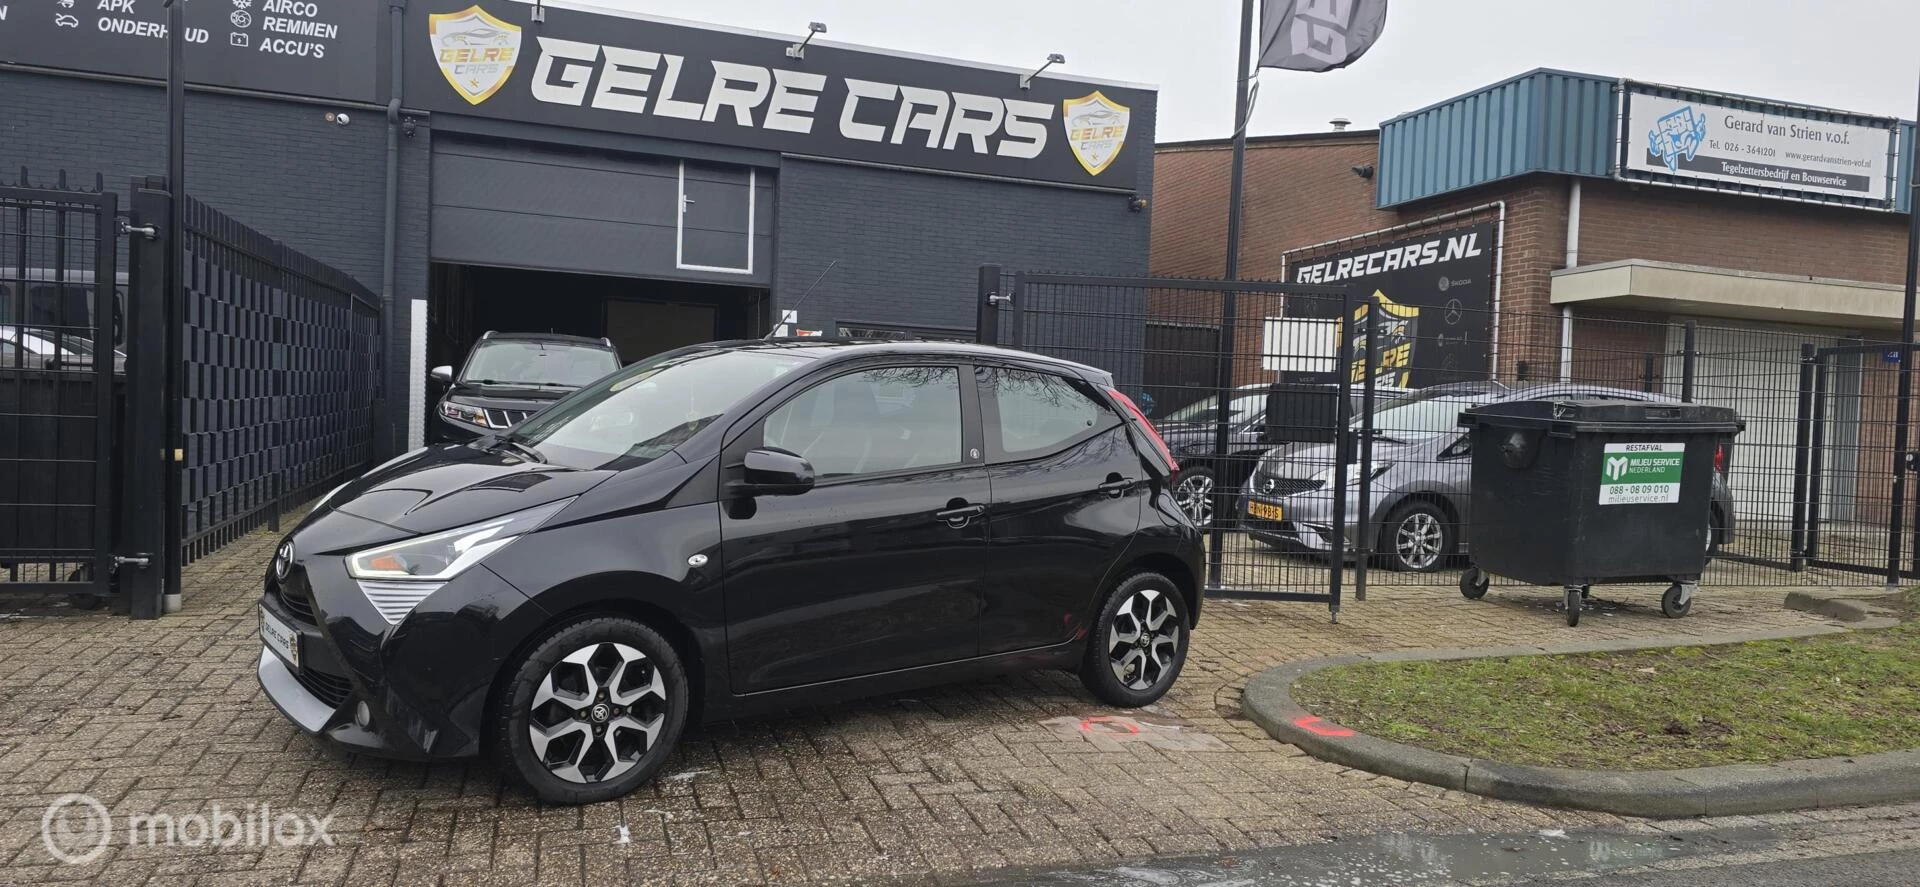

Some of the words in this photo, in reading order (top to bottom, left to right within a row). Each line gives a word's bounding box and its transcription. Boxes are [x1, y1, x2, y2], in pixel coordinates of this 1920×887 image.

[97, 0, 136, 14] APK
[262, 0, 319, 17] AIRCO
[98, 17, 209, 44] ONDERHUD
[263, 16, 338, 39] REMMEN
[259, 37, 325, 59] ACCU'S
[439, 47, 514, 63] GELRE
[454, 64, 499, 75] CARS
[531, 36, 827, 134] GELRE
[839, 77, 1055, 159] CARS
[1070, 125, 1125, 141] GELRE
[1724, 115, 1764, 134] Gerard
[1767, 124, 1786, 137] van
[1790, 124, 1822, 142] Strien
[1825, 131, 1850, 145] v.o.f.
[1724, 142, 1739, 152] 026
[1746, 145, 1776, 157] 3641201
[1785, 151, 1872, 169] www.gerardvanstrien-vof.nl
[1721, 161, 1790, 182] Tegelzettersbedrijf
[1790, 173, 1800, 182] en
[1802, 172, 1847, 187] Bouwservice
[1297, 232, 1482, 285] GELRECARS.NL
[1626, 444, 1663, 452] RESTAFVAL
[1629, 466, 1665, 474] NEDERLAND
[1630, 458, 1652, 466] MILIEU
[1653, 458, 1680, 466] SERVICE
[1609, 485, 1624, 495] 088
[1630, 485, 1640, 494] 08
[1641, 485, 1651, 494] 09
[1653, 485, 1669, 493] 010
[1608, 494, 1669, 504] milieuservice.nl
